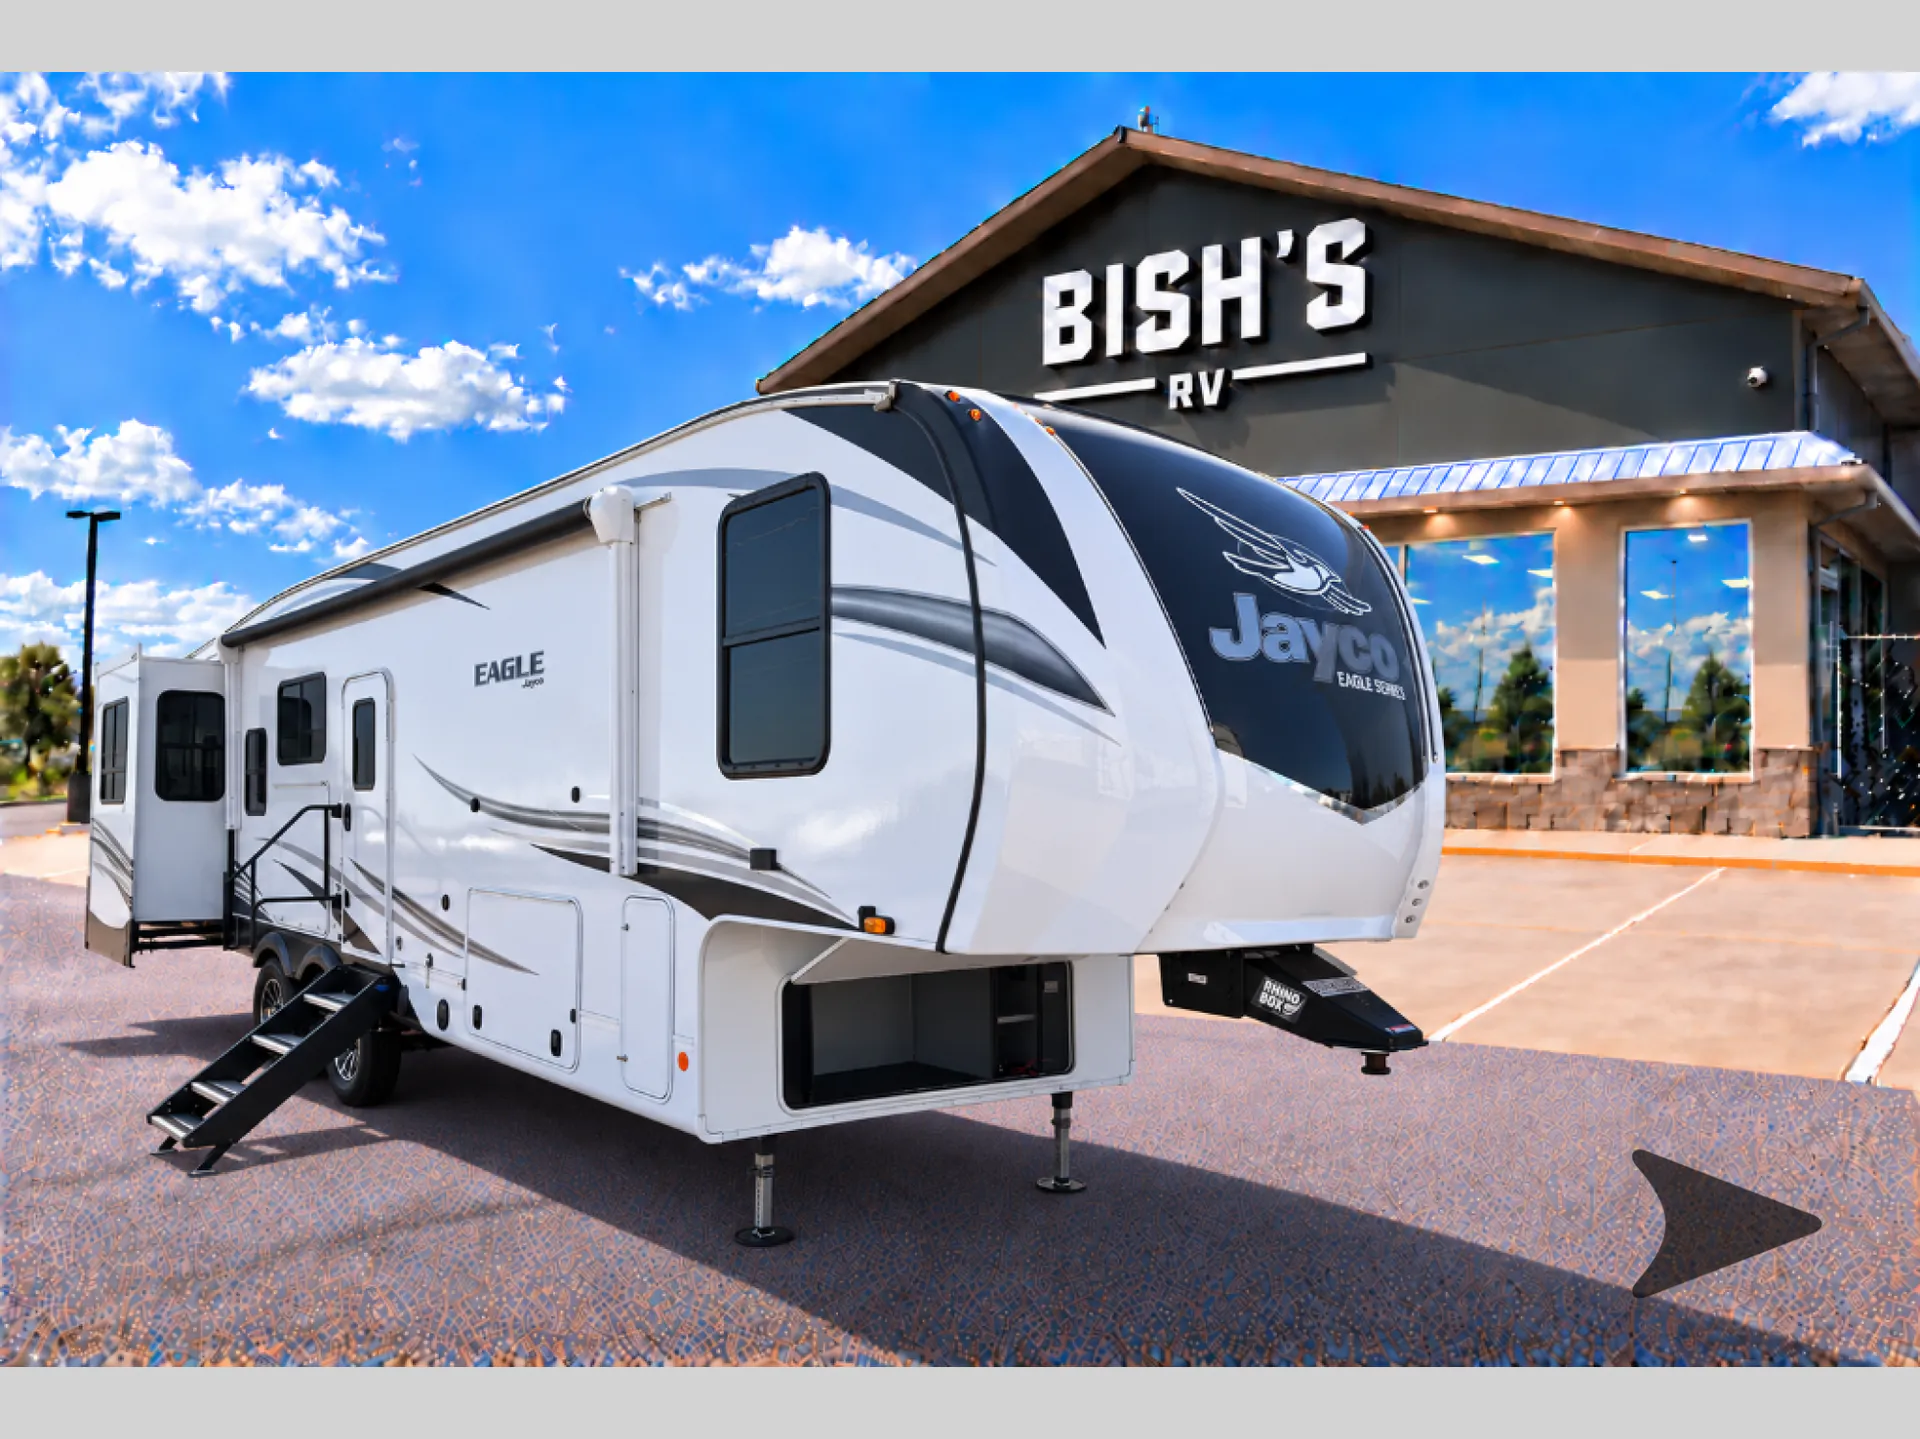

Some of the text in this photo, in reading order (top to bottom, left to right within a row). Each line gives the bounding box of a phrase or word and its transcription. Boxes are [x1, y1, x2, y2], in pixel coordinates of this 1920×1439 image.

[1042, 218, 1366, 366] BISH'S
[1168, 368, 1225, 410] RV
[1209, 592, 1400, 683] Jayco
[474, 650, 544, 687] EAGLE
[1337, 671, 1373, 692] EAGLE
[1259, 991, 1283, 1012] BOX
[1263, 980, 1300, 1004] RHINO
